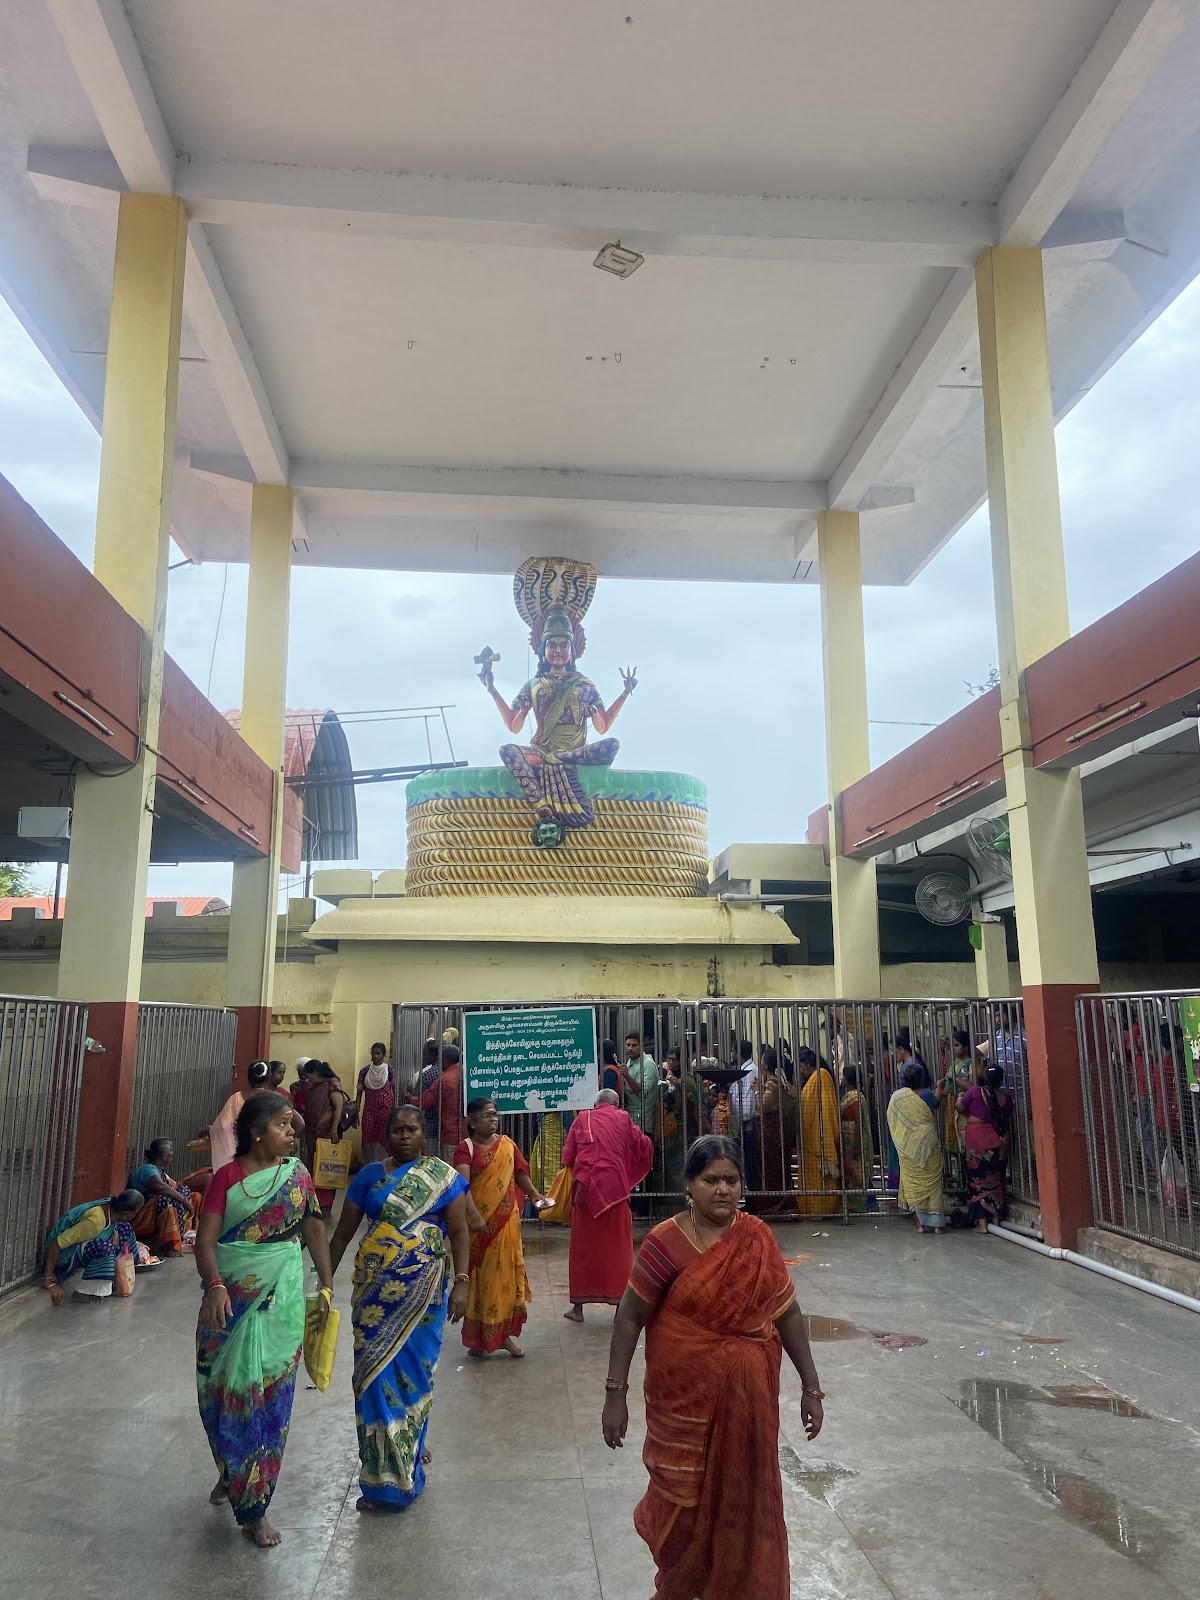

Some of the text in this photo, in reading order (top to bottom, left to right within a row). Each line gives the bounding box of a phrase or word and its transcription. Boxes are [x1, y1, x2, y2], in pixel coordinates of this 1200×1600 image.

[486, 1036, 574, 1050] இத்திருக்கோயிலுக்கு வருகைதரும்
[513, 1054, 528, 1063] தடை
